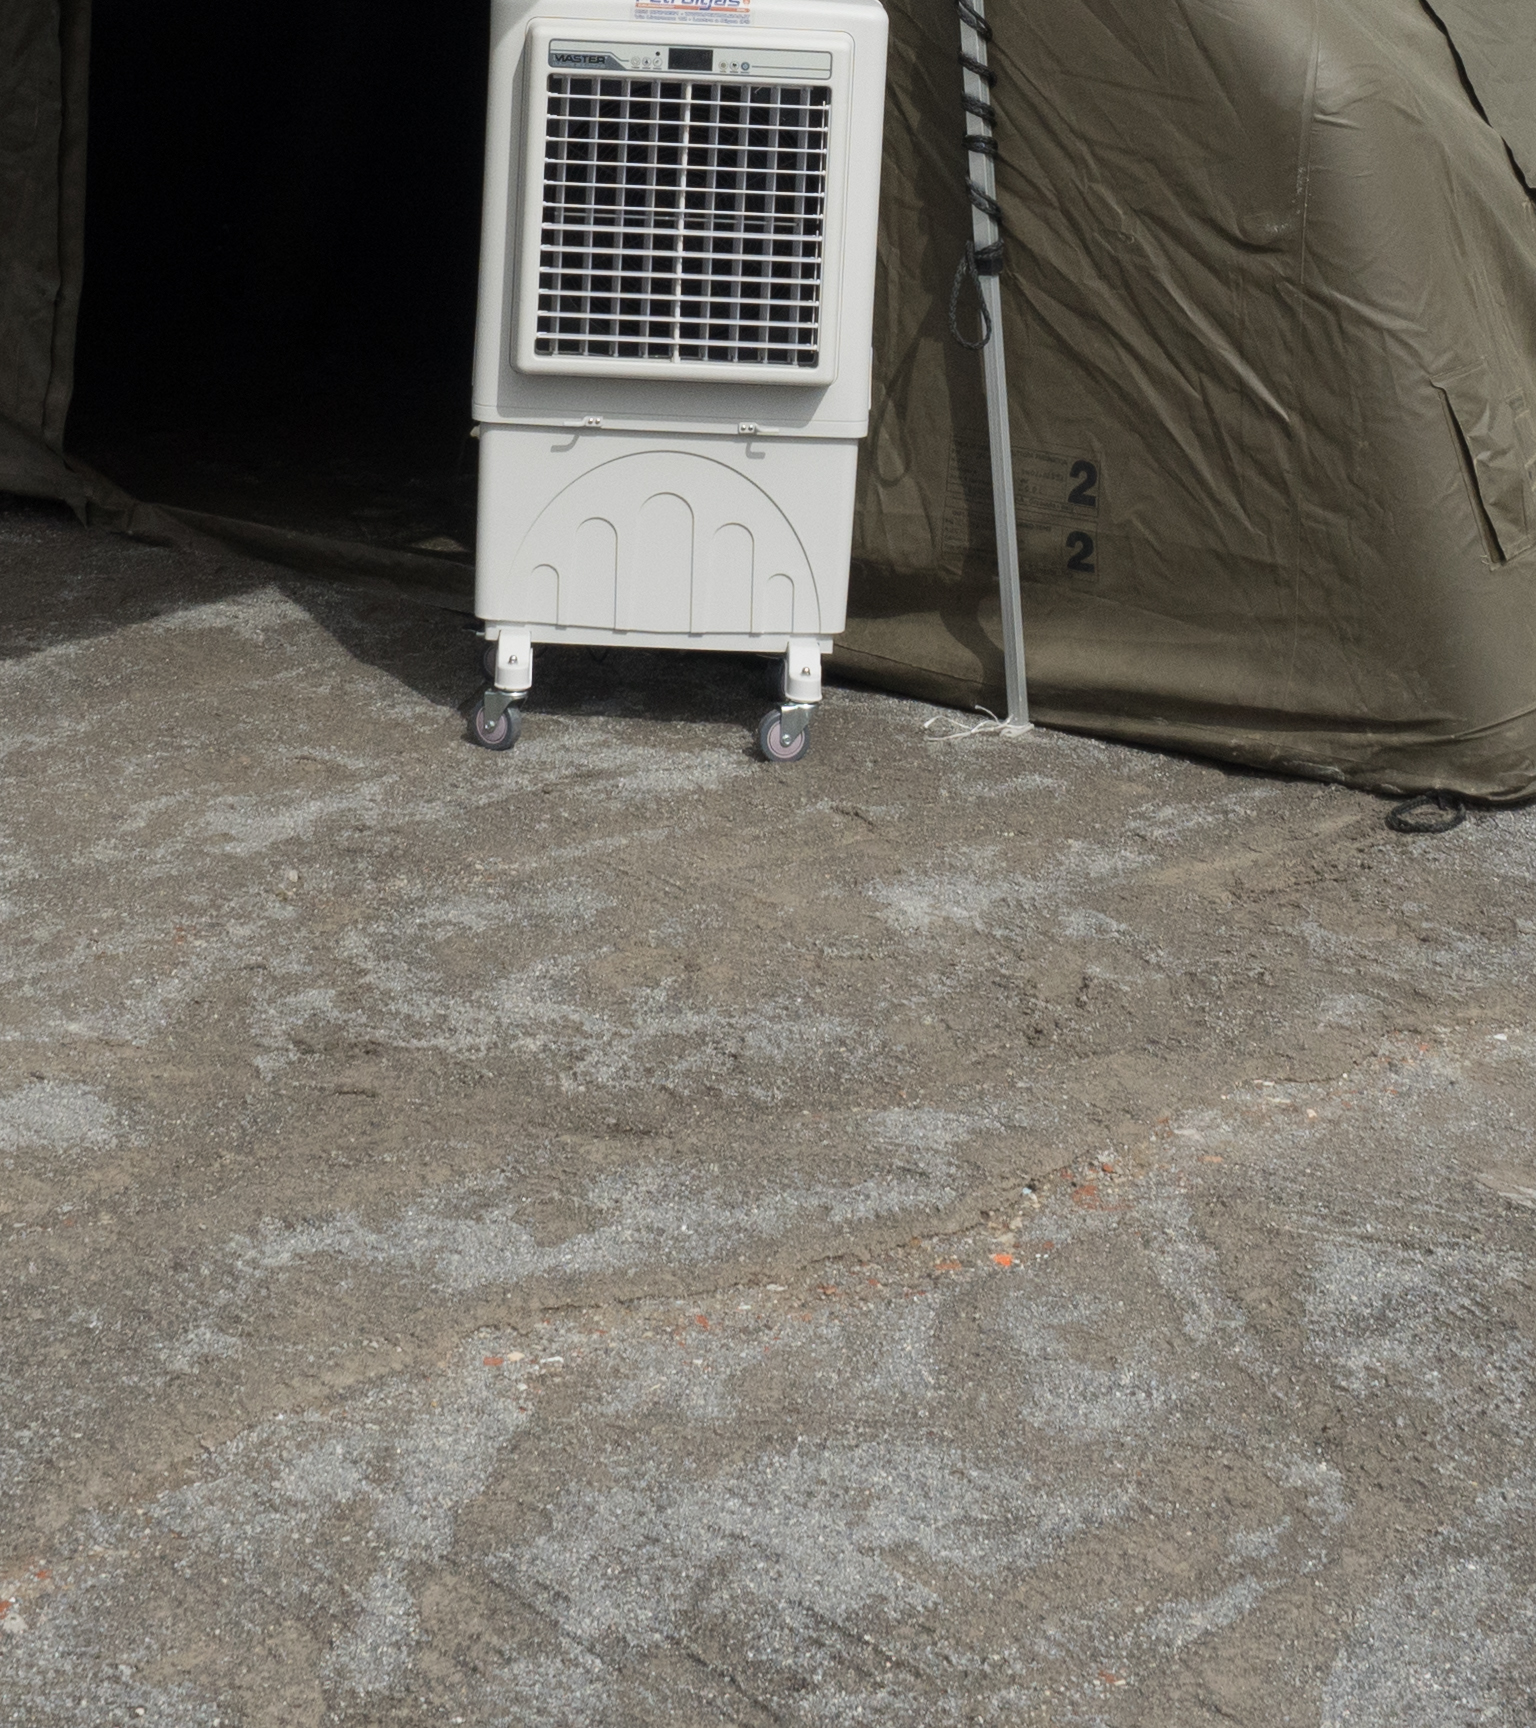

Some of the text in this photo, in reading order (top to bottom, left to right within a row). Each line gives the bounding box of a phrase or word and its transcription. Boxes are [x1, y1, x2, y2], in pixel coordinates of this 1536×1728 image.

[554, 54, 606, 64] MASTER
[1068, 459, 1097, 507] 2
[1066, 530, 1095, 573] 2
